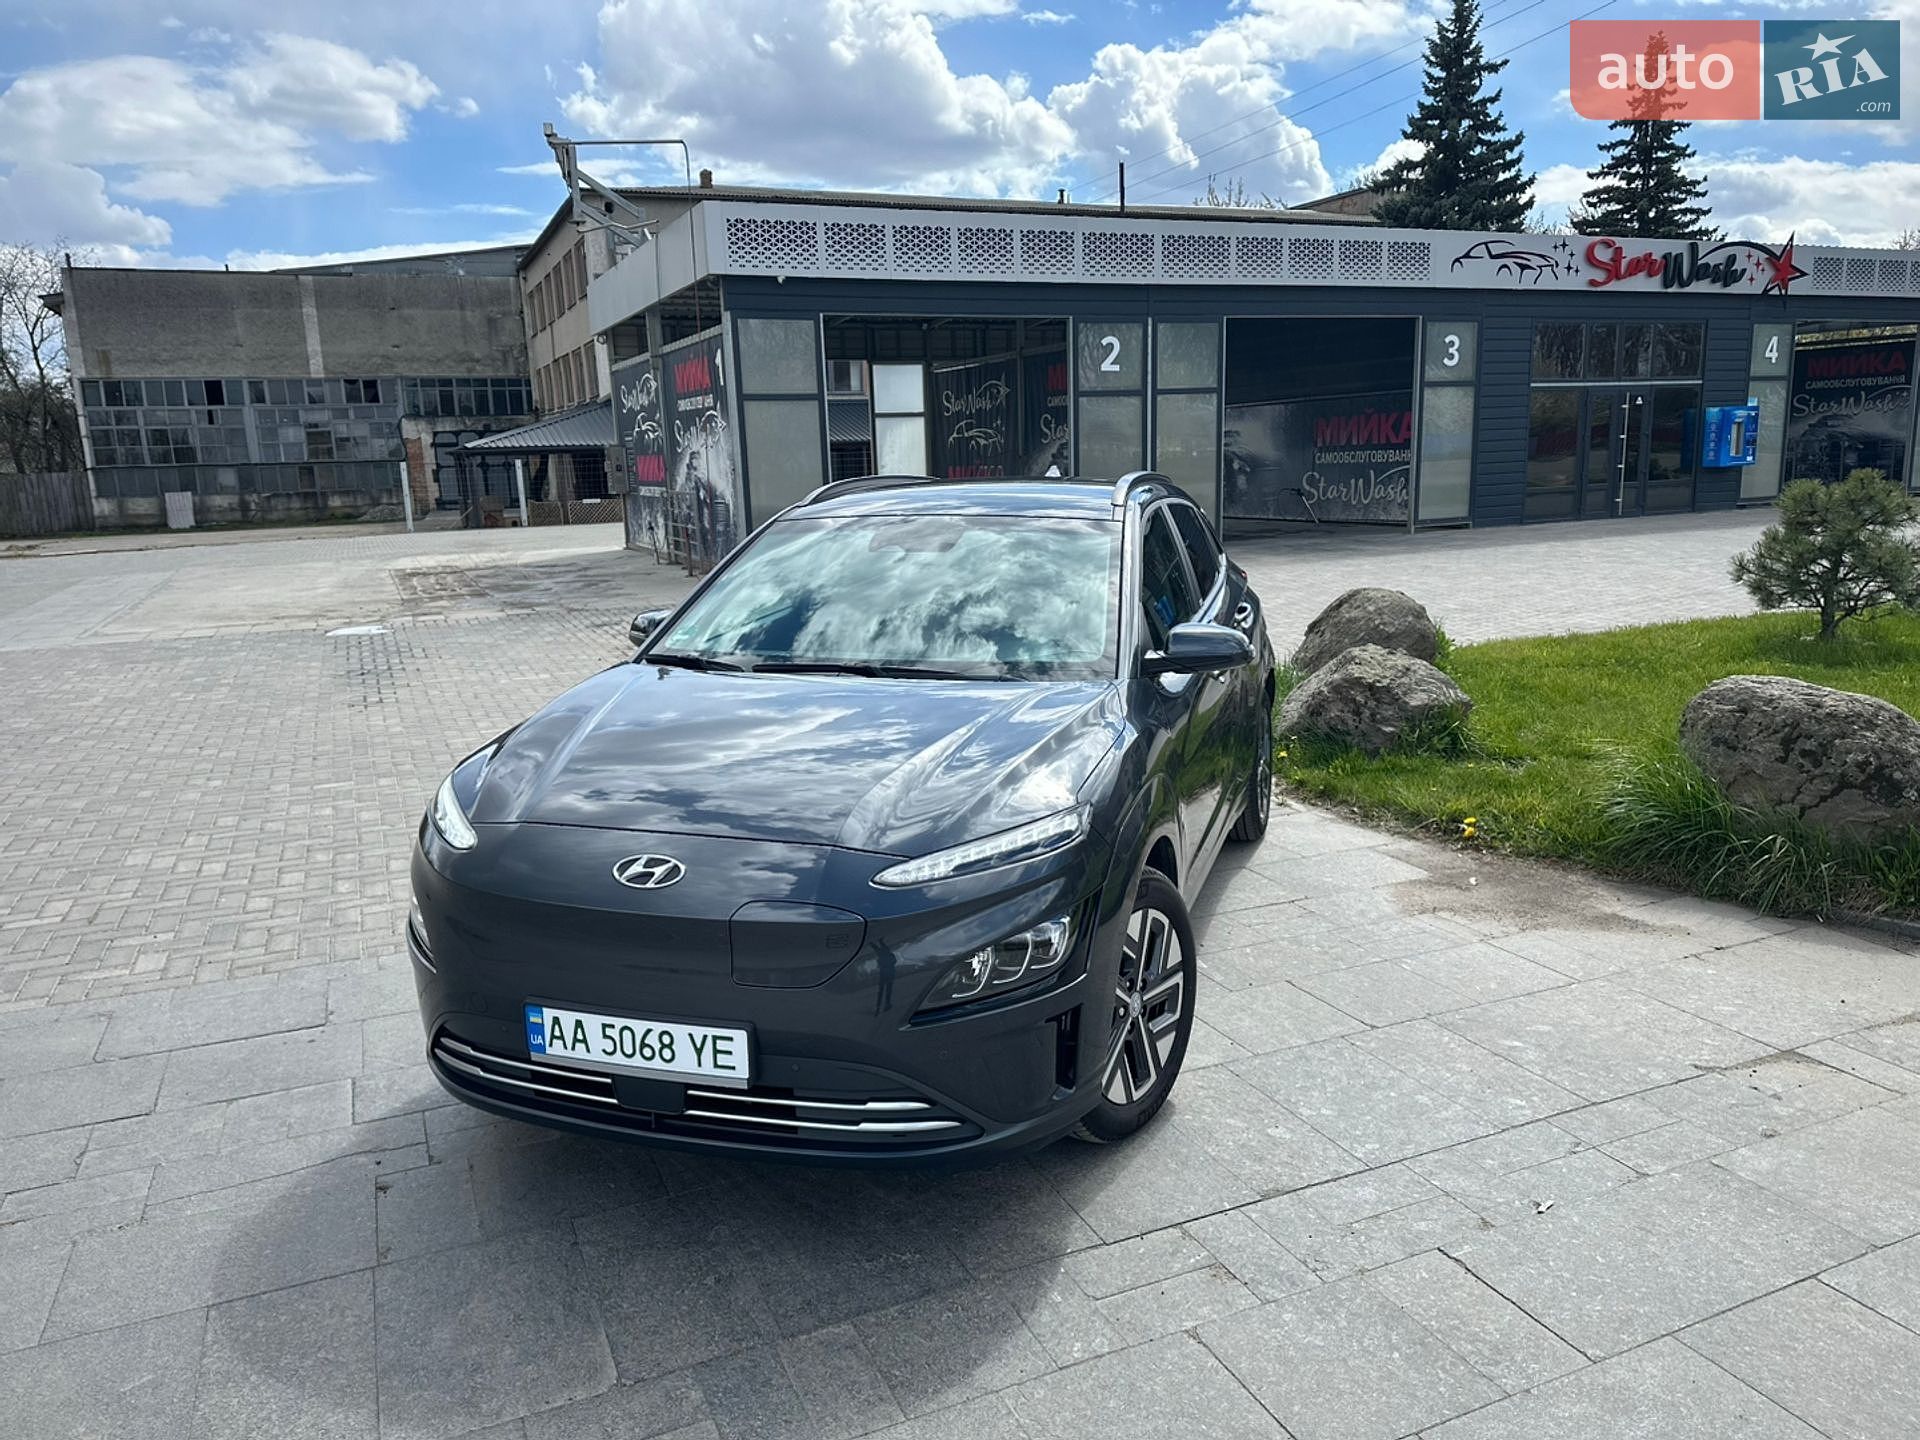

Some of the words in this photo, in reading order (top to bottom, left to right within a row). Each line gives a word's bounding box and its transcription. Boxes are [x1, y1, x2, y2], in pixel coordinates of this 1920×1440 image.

[1100, 335, 1120, 372] 2
[1442, 334, 1460, 367] 3
[1764, 335, 1778, 363] 4
[714, 348, 724, 386] 1
[530, 1034, 544, 1046] UA
[548, 1016, 590, 1053] AA
[601, 1022, 675, 1063] 5068
[688, 1033, 736, 1070] YE
